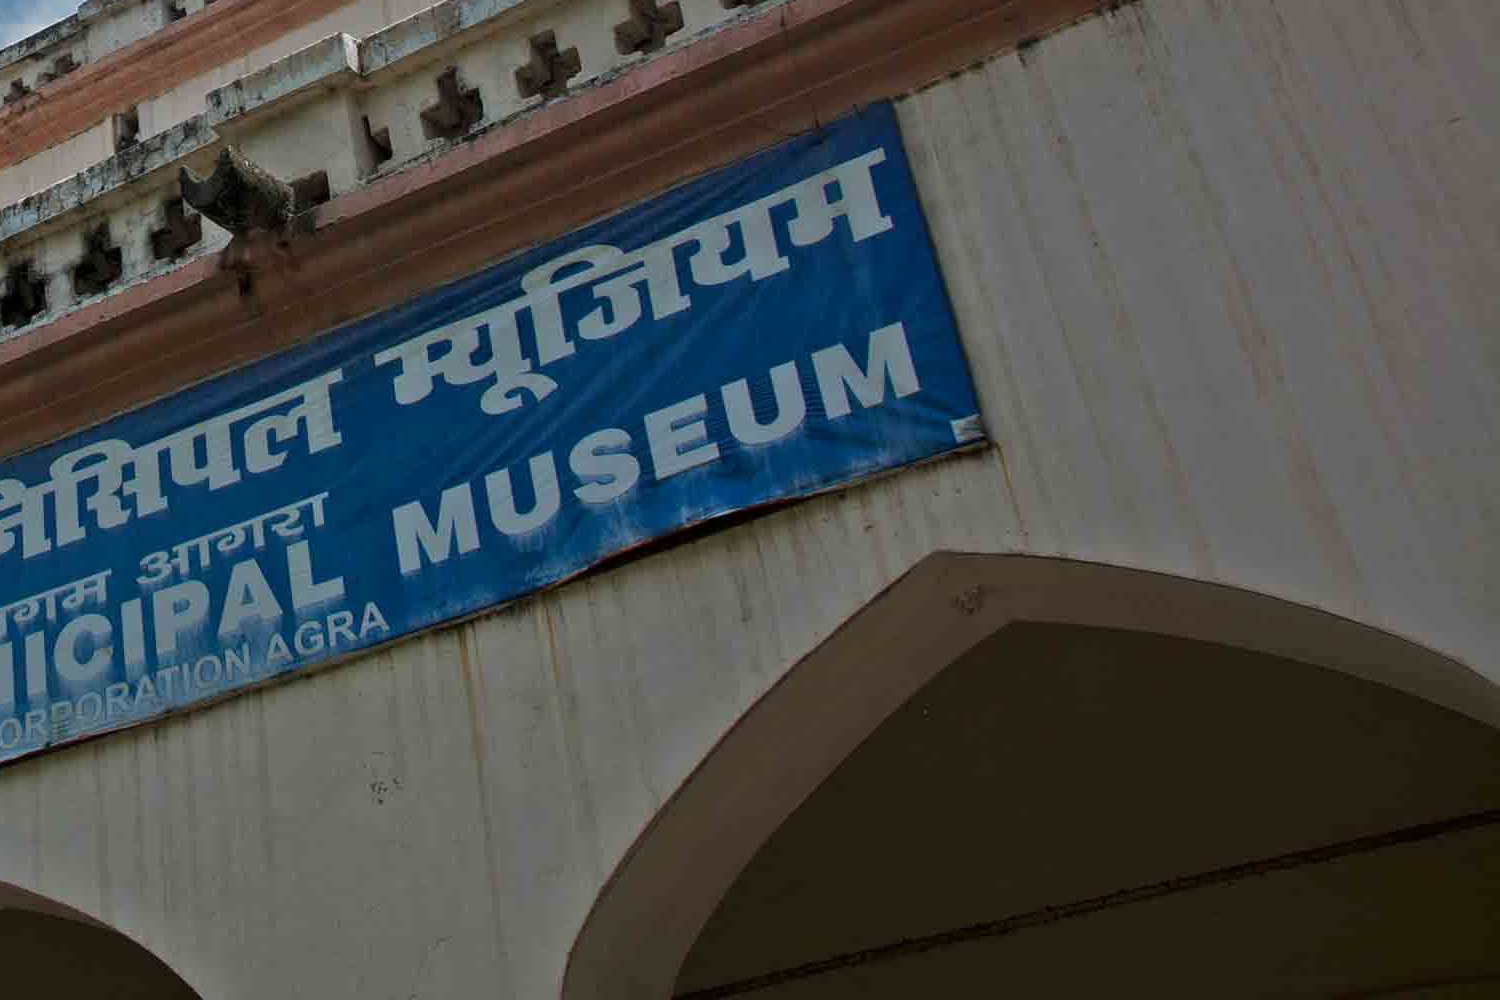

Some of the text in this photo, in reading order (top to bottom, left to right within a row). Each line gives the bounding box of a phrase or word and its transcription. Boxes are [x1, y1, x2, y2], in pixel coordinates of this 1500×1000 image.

[375, 147, 893, 415] म्यूजियम
[392, 322, 920, 576] MUSEUM
[136, 493, 329, 586] आगरा
[265, 600, 390, 664] AGRA
